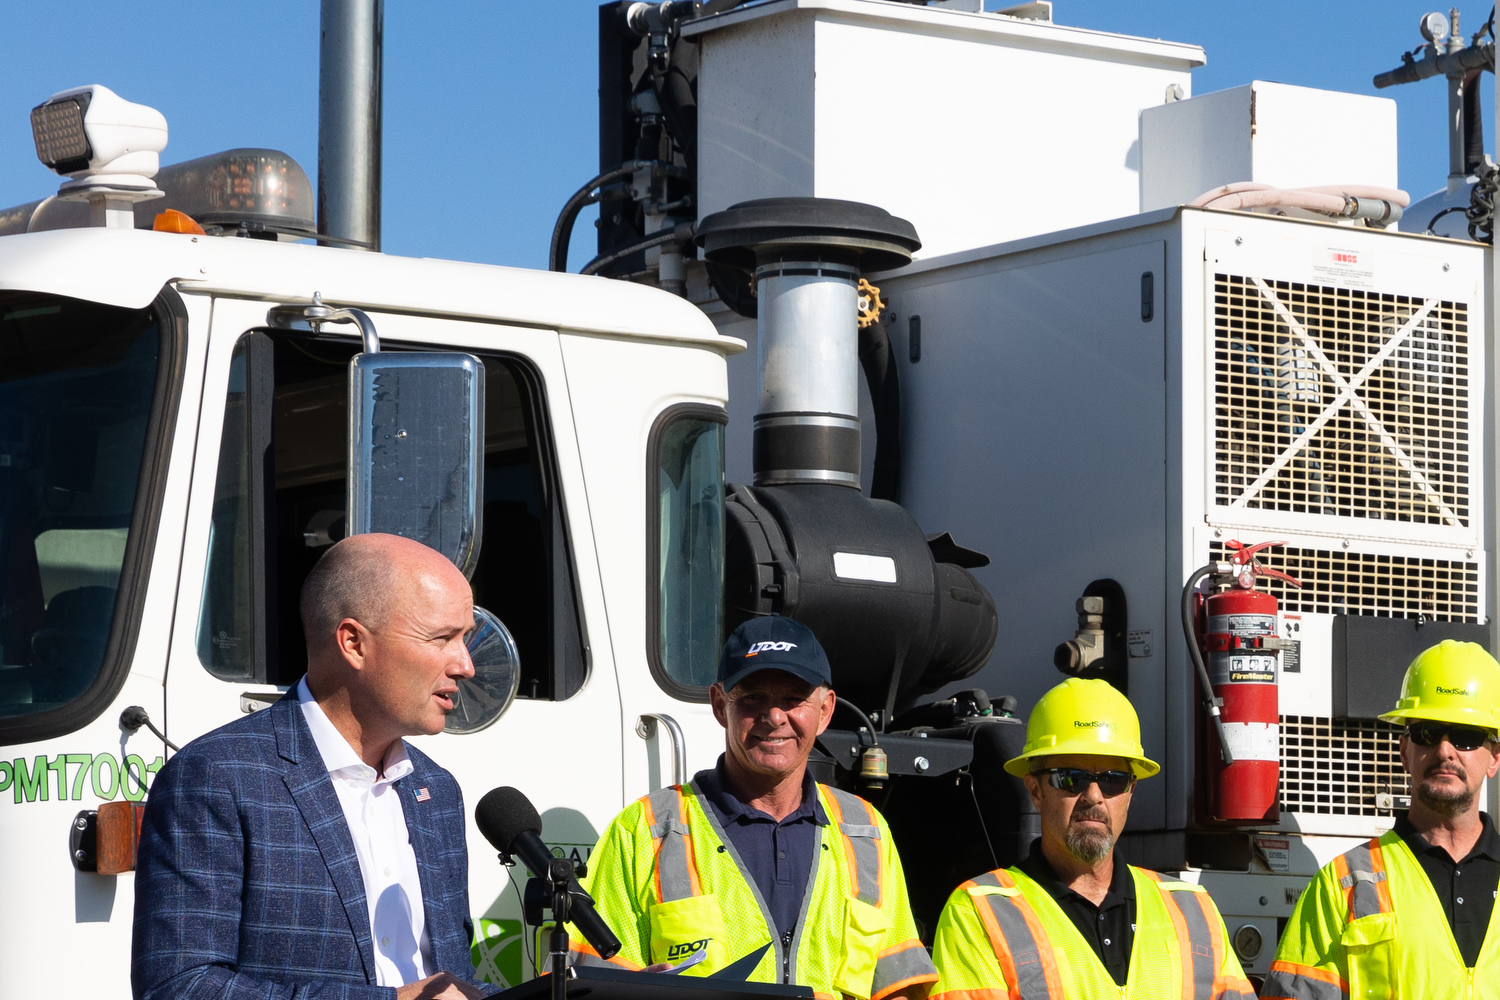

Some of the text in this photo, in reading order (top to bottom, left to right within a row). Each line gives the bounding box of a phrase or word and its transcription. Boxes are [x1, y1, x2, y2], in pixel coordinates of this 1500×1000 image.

[748, 641, 798, 654] UDOT
[1231, 672, 1274, 680] FireMaster
[1435, 686, 1470, 696] RoadSafe
